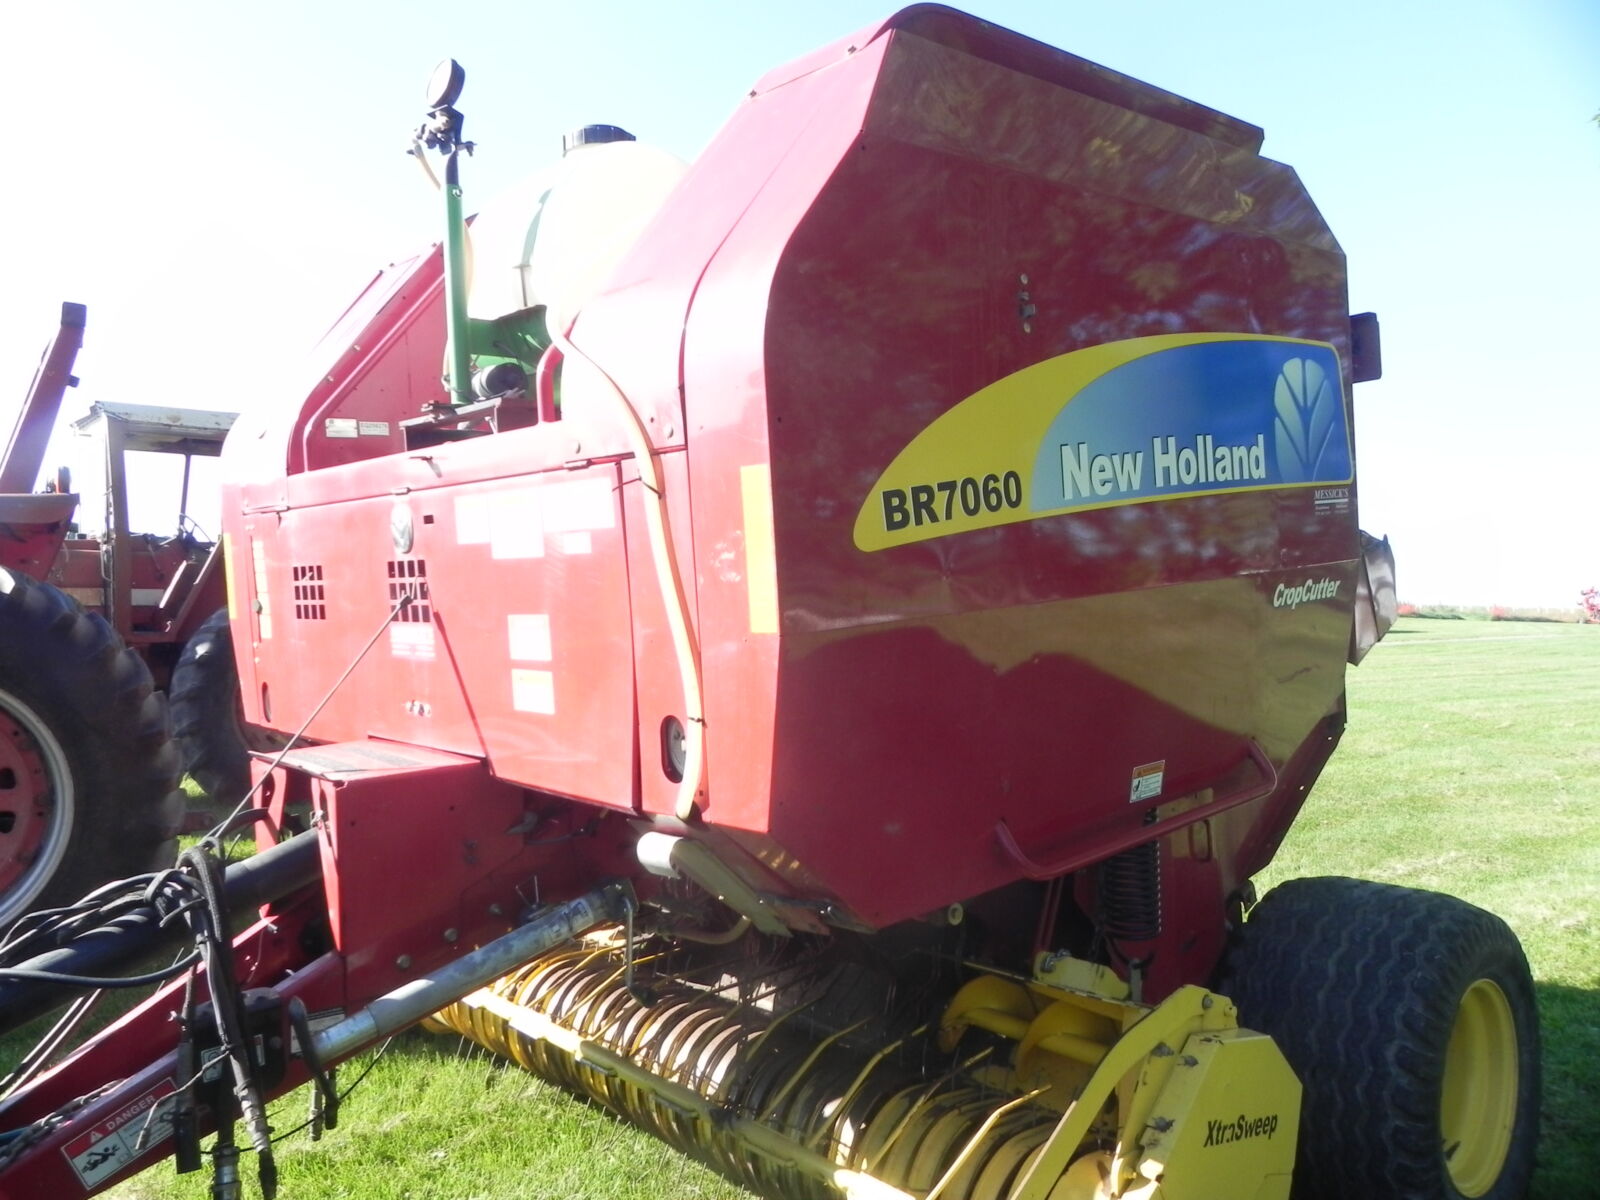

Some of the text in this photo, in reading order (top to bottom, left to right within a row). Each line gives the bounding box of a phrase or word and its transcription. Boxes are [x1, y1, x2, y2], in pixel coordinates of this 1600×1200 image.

[1060, 434, 1266, 500] New Holland
[882, 470, 1022, 532] BR7060
[1273, 577, 1341, 610] CropCutter
[106, 1094, 156, 1131] DANGER
[1203, 1114, 1278, 1148] XtraSweep
